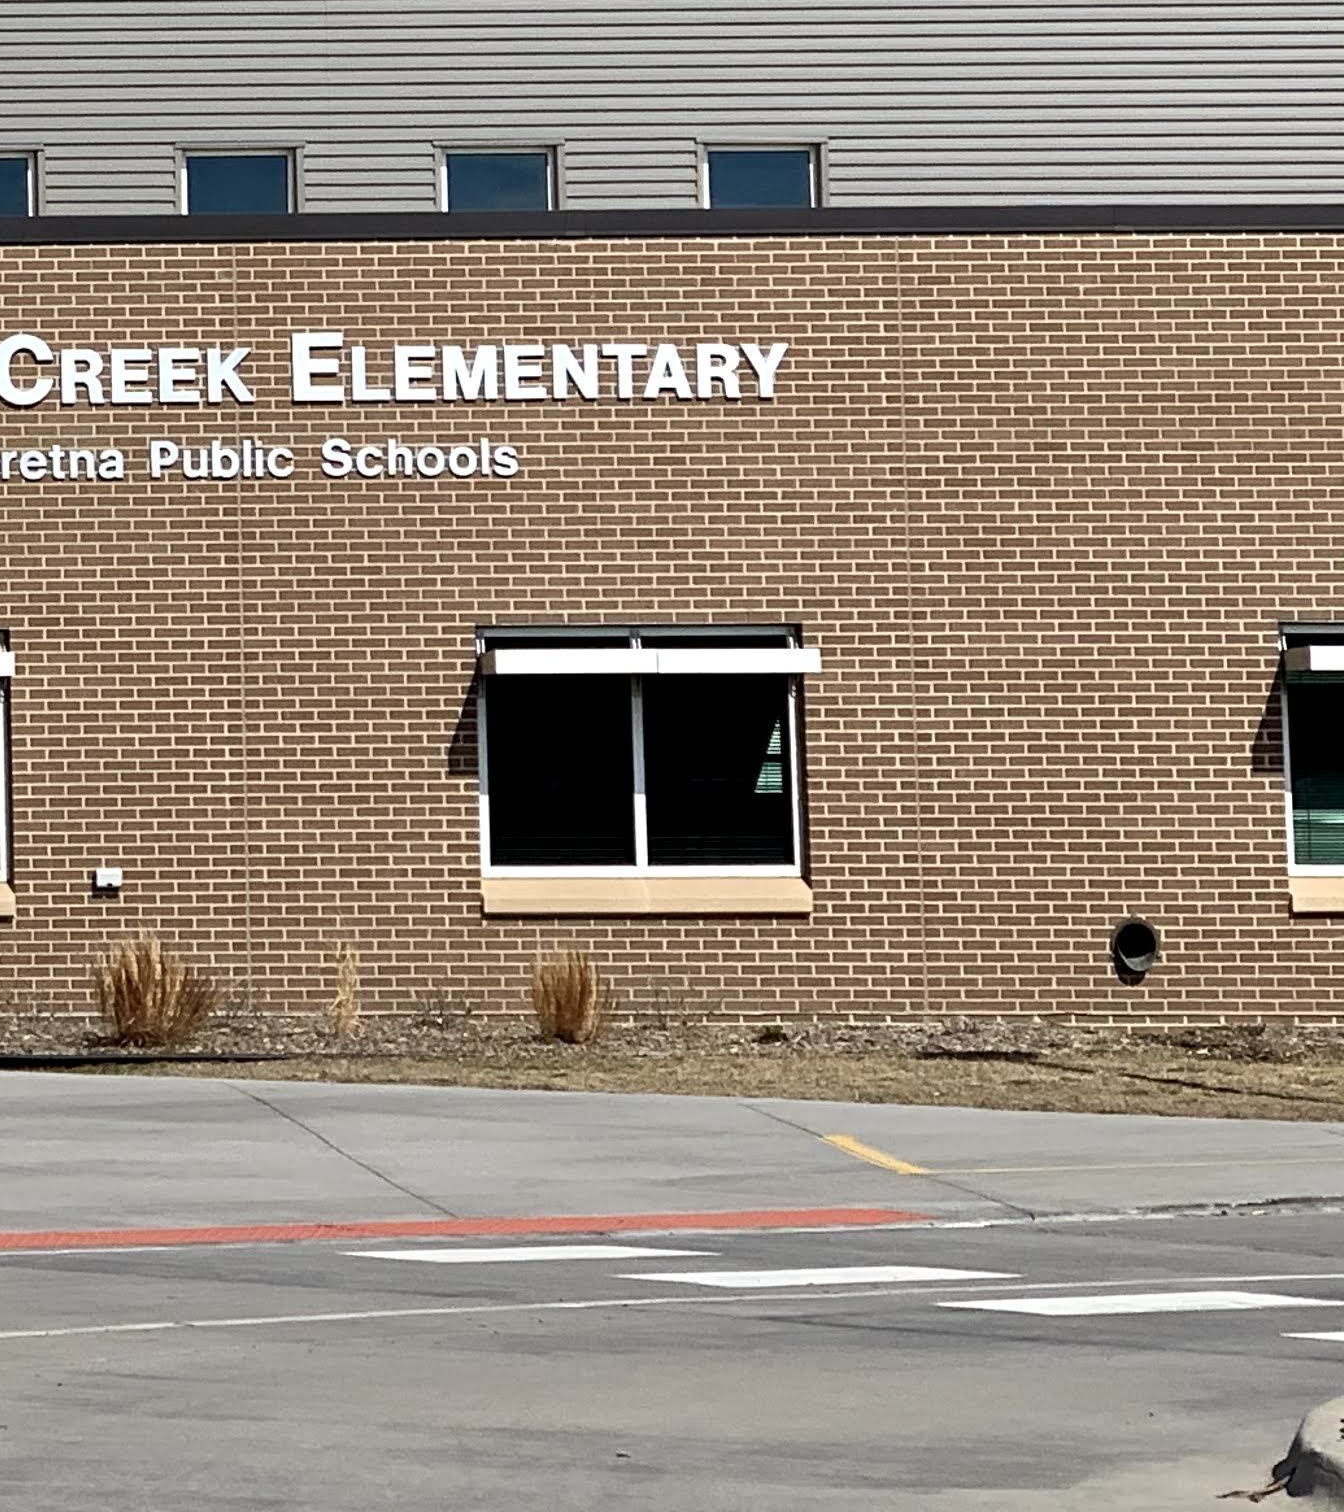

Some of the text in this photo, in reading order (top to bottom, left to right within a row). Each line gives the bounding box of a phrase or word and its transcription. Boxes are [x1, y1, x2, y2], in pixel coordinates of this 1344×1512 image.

[291, 332, 788, 402] ELEMENTARY
[150, 439, 294, 479] Public
[321, 437, 519, 478] Schools
